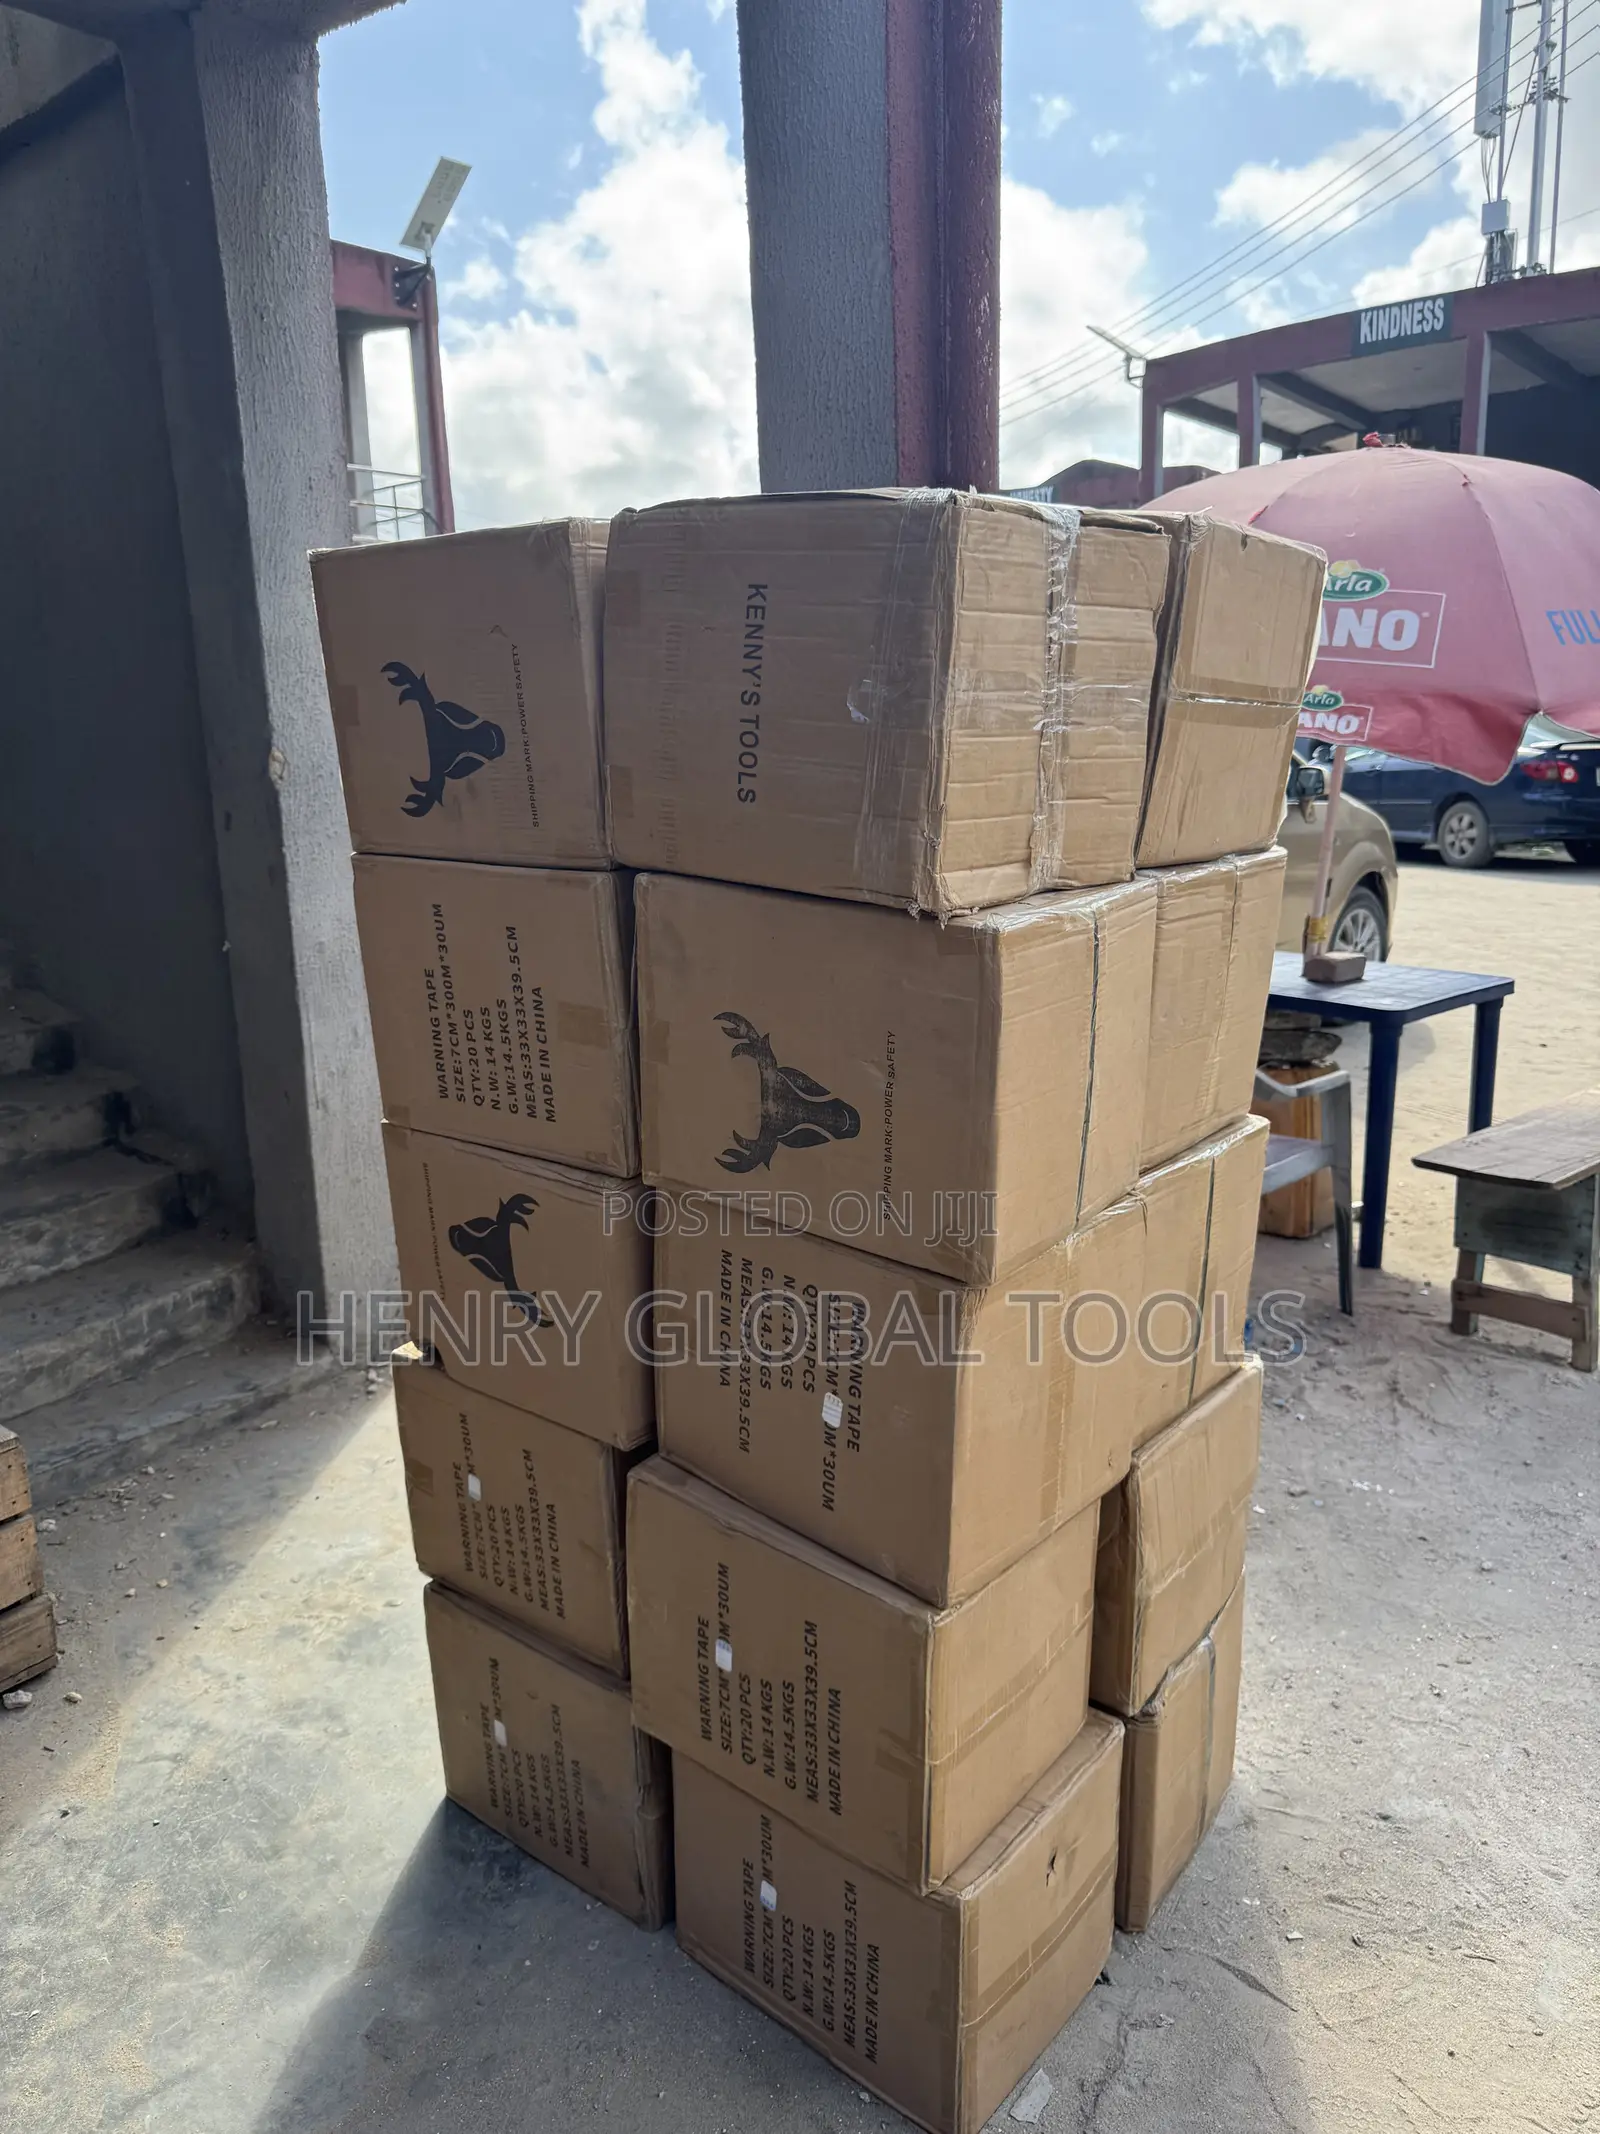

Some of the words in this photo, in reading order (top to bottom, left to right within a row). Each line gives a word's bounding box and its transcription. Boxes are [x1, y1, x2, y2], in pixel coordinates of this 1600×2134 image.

[1360, 298, 1444, 344] KINDNESS
[511, 644, 523, 690] SAFETY
[740, 584, 768, 707] KENNY'S
[1304, 693, 1335, 705] Arla
[737, 715, 759, 803] TOOLS
[527, 775, 539, 827] SHIPPING
[425, 968, 438, 1012] TAPE
[463, 1009, 478, 1043] PCS
[480, 1006, 494, 1042] KGS
[532, 986, 547, 1045] CHINA
[430, 1018, 449, 1099] WARNING
[487, 1045, 496, 1067] 14
[541, 1053, 550, 1068] IN
[887, 1031, 896, 1080] SAFETY
[540, 1070, 556, 1122] MADE
[883, 1165, 893, 1220] SHIPPING
[720, 1249, 732, 1302] MADE
[720, 1304, 731, 1328] IN
[719, 1329, 731, 1387] CHINA
[780, 1351, 793, 1389] KGS
[848, 1300, 866, 1399] WARNING
[802, 1357, 816, 1393] PCS
[847, 1404, 861, 1452] TAPE
[453, 1462, 465, 1498] TAPE
[457, 1501, 473, 1572] WARNING
[486, 1504, 499, 1534] PCS
[501, 1507, 512, 1535] KGS
[546, 1504, 559, 1552] CHINA
[550, 1558, 560, 1572] IN
[551, 1573, 566, 1619] MADE
[697, 1615, 709, 1660] TAPE
[697, 1664, 712, 1742] WARNING
[738, 1672, 751, 1705] PCS
[760, 1678, 773, 1714] KGS
[761, 1715, 774, 1737] 14
[827, 1687, 841, 1744] CHINA
[828, 1747, 841, 1763] IN
[828, 1764, 842, 1816] MADE
[742, 1858, 755, 1896] TAPE
[742, 1899, 756, 1974] WARNING
[782, 1915, 794, 1946] PCS
[802, 1923, 815, 1958] KGS
[867, 1943, 880, 1995] CHINA
[866, 1998, 879, 2013] IN
[864, 2014, 877, 2064] MADE
